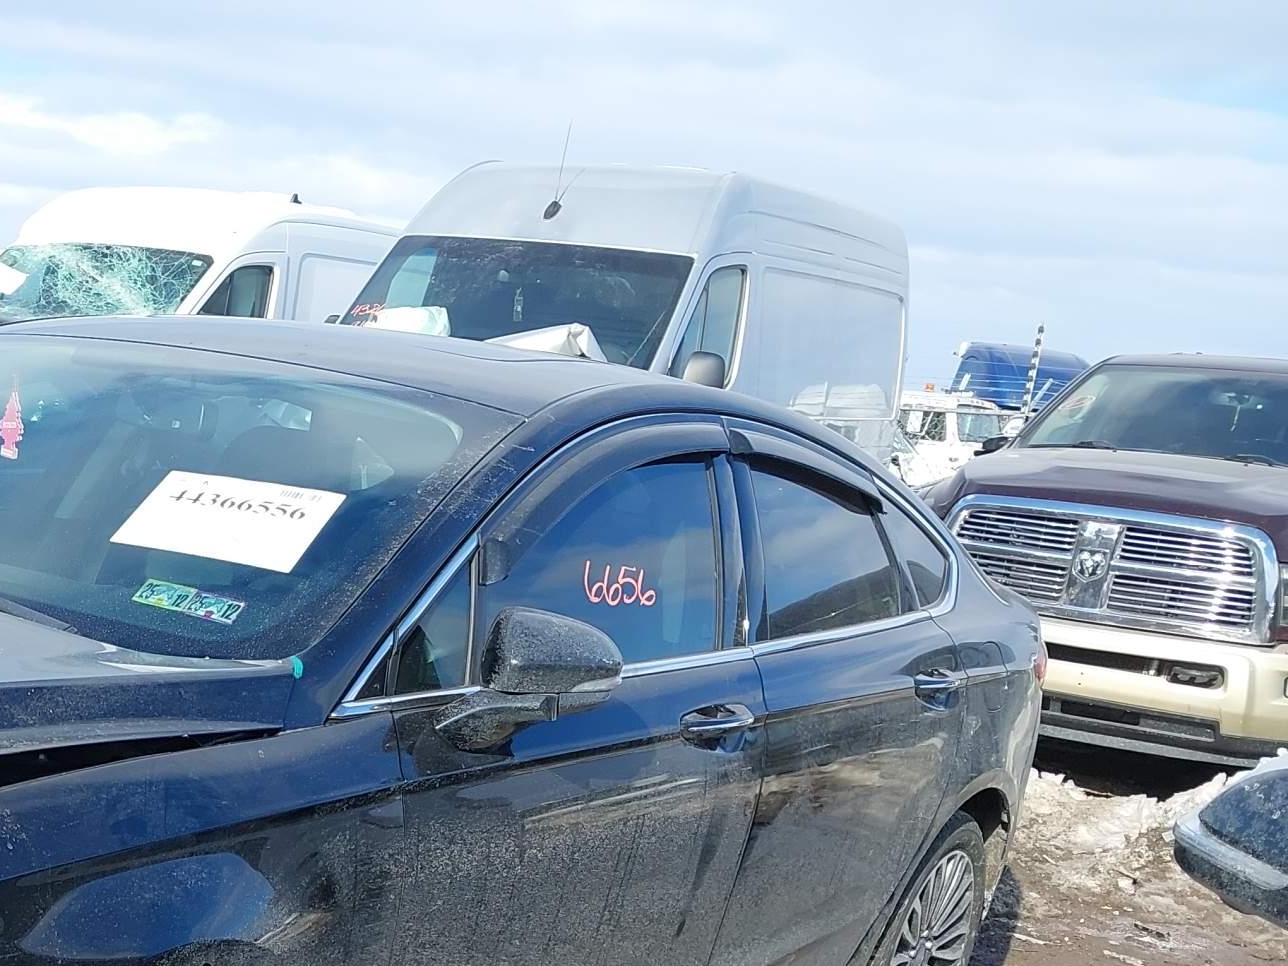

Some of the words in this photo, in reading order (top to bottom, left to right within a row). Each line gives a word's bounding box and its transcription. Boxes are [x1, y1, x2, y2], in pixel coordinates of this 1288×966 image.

[169, 490, 306, 520] 44366556
[584, 560, 656, 606] 6656
[172, 593, 190, 608] 12
[220, 602, 243, 621] 12
